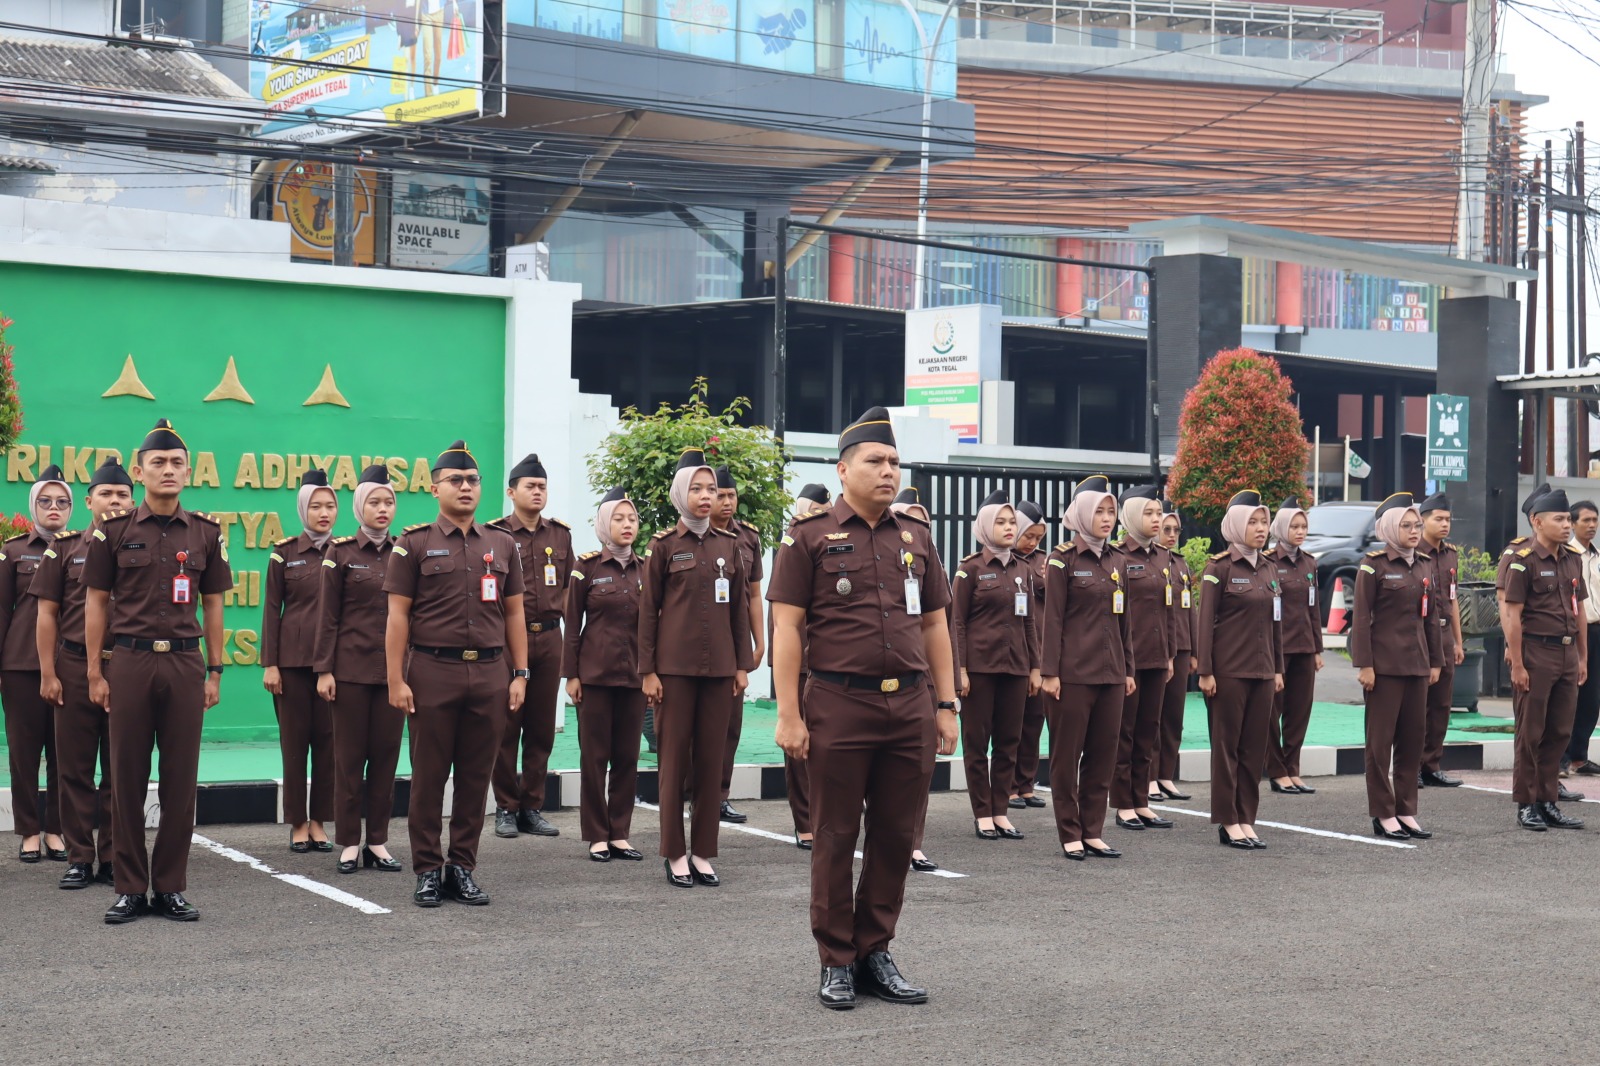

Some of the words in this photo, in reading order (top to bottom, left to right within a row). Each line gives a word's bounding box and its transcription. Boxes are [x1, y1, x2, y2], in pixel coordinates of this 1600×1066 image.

[269, 71, 294, 96] YOUR
[296, 50, 345, 85] SHOPPING
[346, 40, 368, 66] DAY
[283, 86, 323, 110] SUPERMALL
[324, 78, 348, 93] TEGAL
[292, 206, 314, 236] Always
[397, 222, 460, 239] AVAILABLE
[397, 235, 432, 248] SPACE
[514, 263, 527, 273] ATM
[7, 444, 51, 482] RI
[1430, 454, 1444, 467] TITIK
[1445, 455, 1465, 468] KUMPUL
[209, 511, 284, 549] TYA
